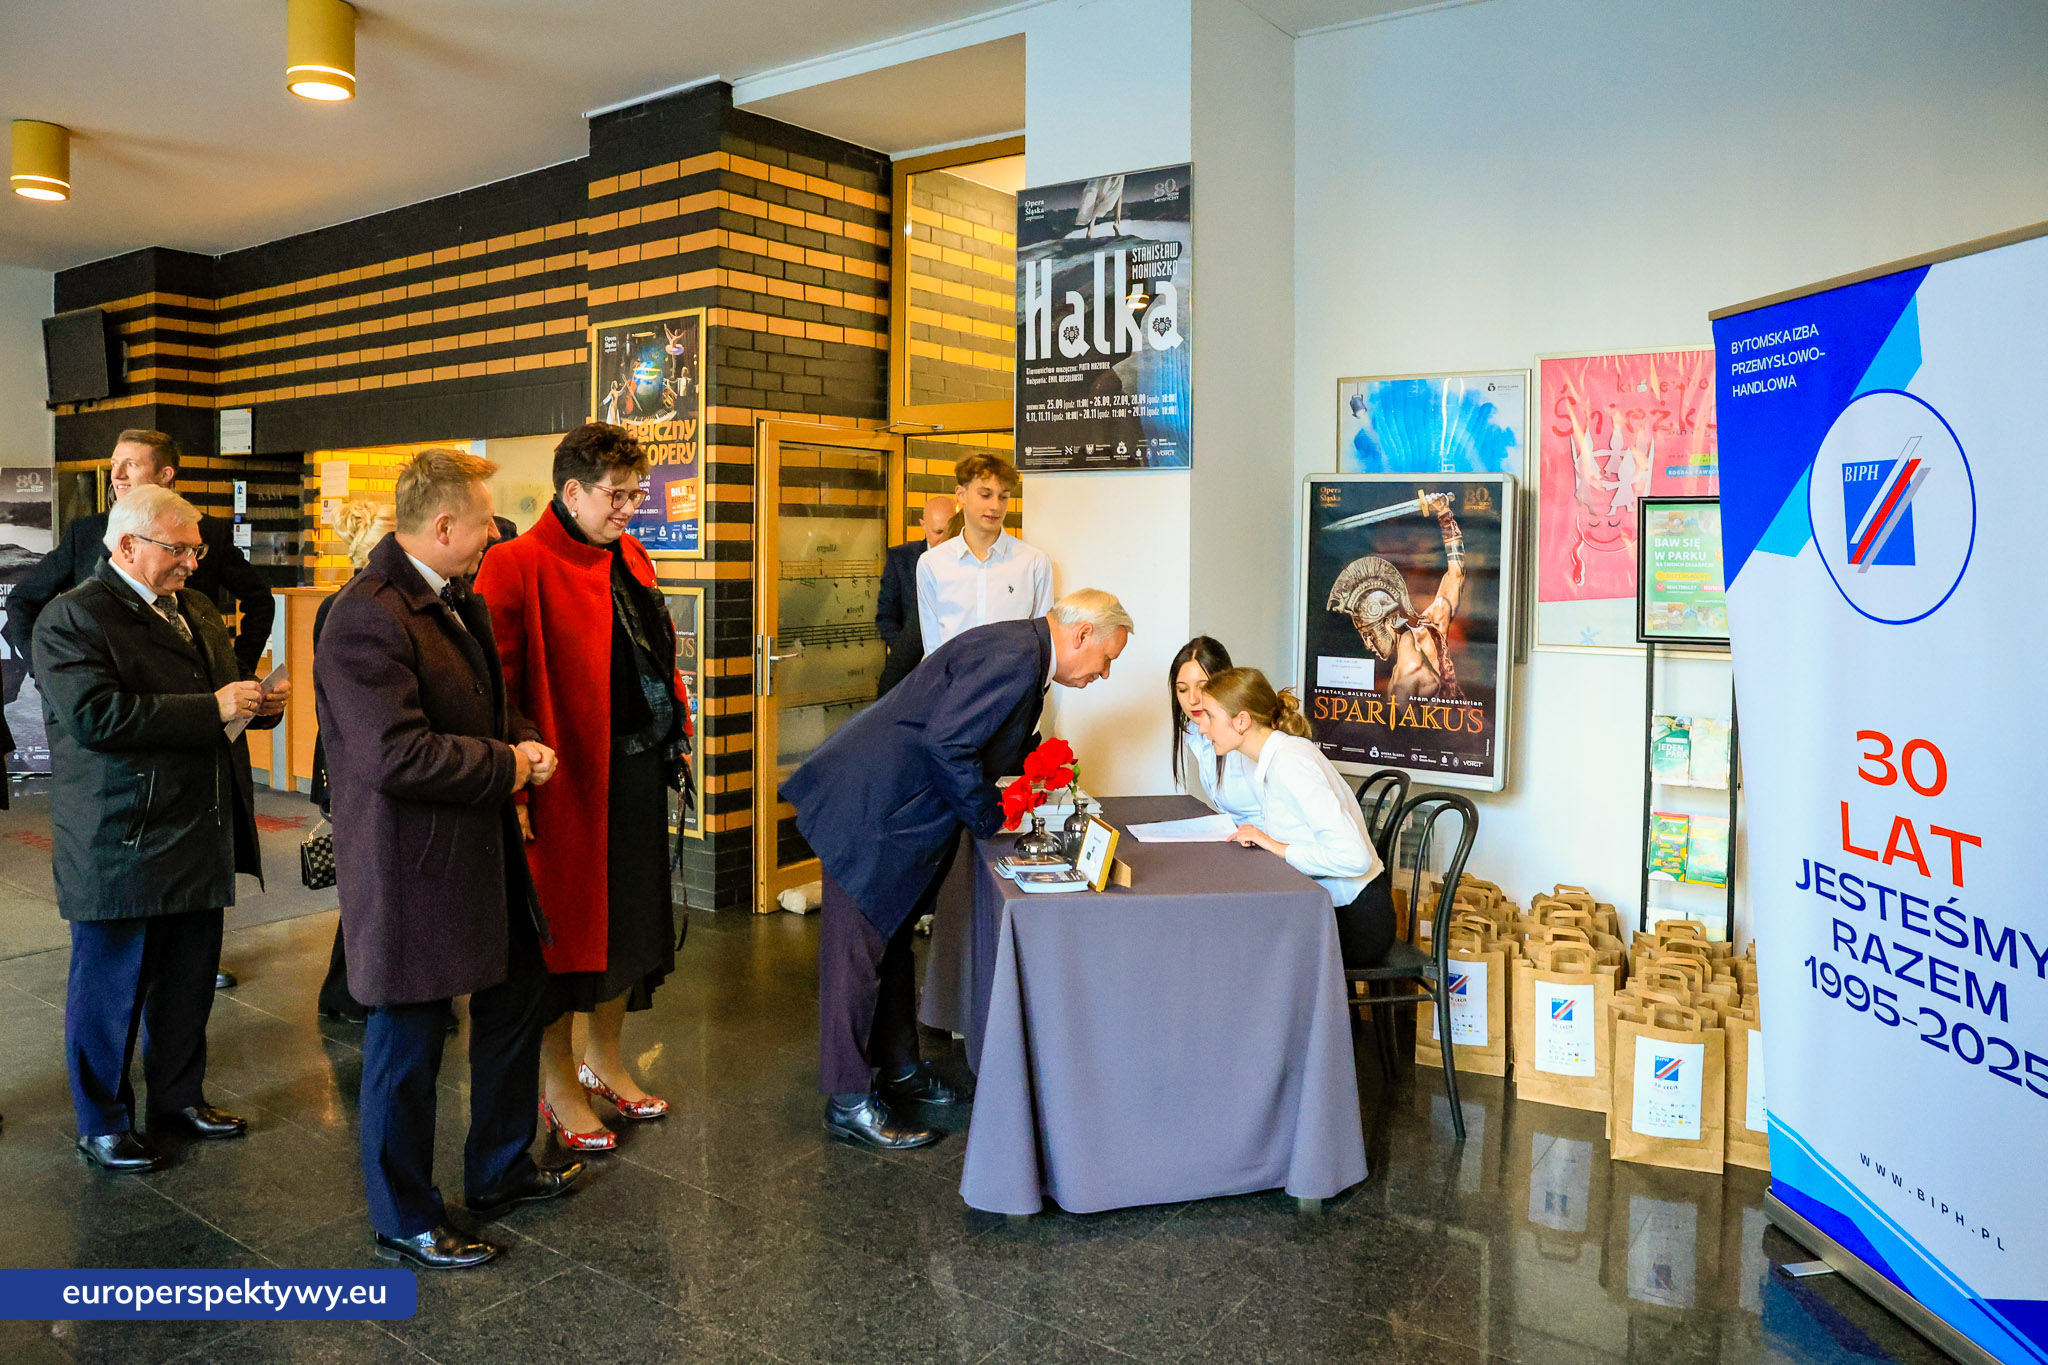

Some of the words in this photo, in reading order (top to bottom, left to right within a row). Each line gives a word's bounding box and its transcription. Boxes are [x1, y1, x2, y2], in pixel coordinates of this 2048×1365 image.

[1025, 199, 1045, 208] Opera
[1025, 207, 1045, 217] Śląska
[1132, 243, 1179, 263] STANISŁAW
[1132, 260, 1178, 280] MONIUSZKO
[1025, 249, 1185, 361] Halka
[1731, 329, 1792, 355] BYTOMSKA
[1792, 323, 1820, 342] IZBA
[1731, 346, 1826, 377] PRZEMYSŁOWO-
[1732, 374, 1798, 398] HANDLOWA
[1046, 399, 1063, 410] 25.09
[647, 441, 697, 467] OPERY
[1844, 463, 1880, 483] BIPH
[1319, 486, 1341, 495] Opera
[1654, 537, 1680, 548] BAW
[1682, 538, 1701, 550] SIĘ
[1654, 551, 1666, 561] W
[1667, 551, 1707, 561] PARKU
[1408, 695, 1429, 703] Aram
[1657, 743, 1684, 752] JEDEN
[1855, 728, 1949, 798] 30
[1840, 800, 1982, 889] LAT
[1794, 857, 2048, 981] JESTEŚMY
[1831, 916, 2010, 1024] RAZEM
[1804, 954, 2048, 1100] 1995-2025
[1859, 1152, 2005, 1252] WWW.BIPH.PL
